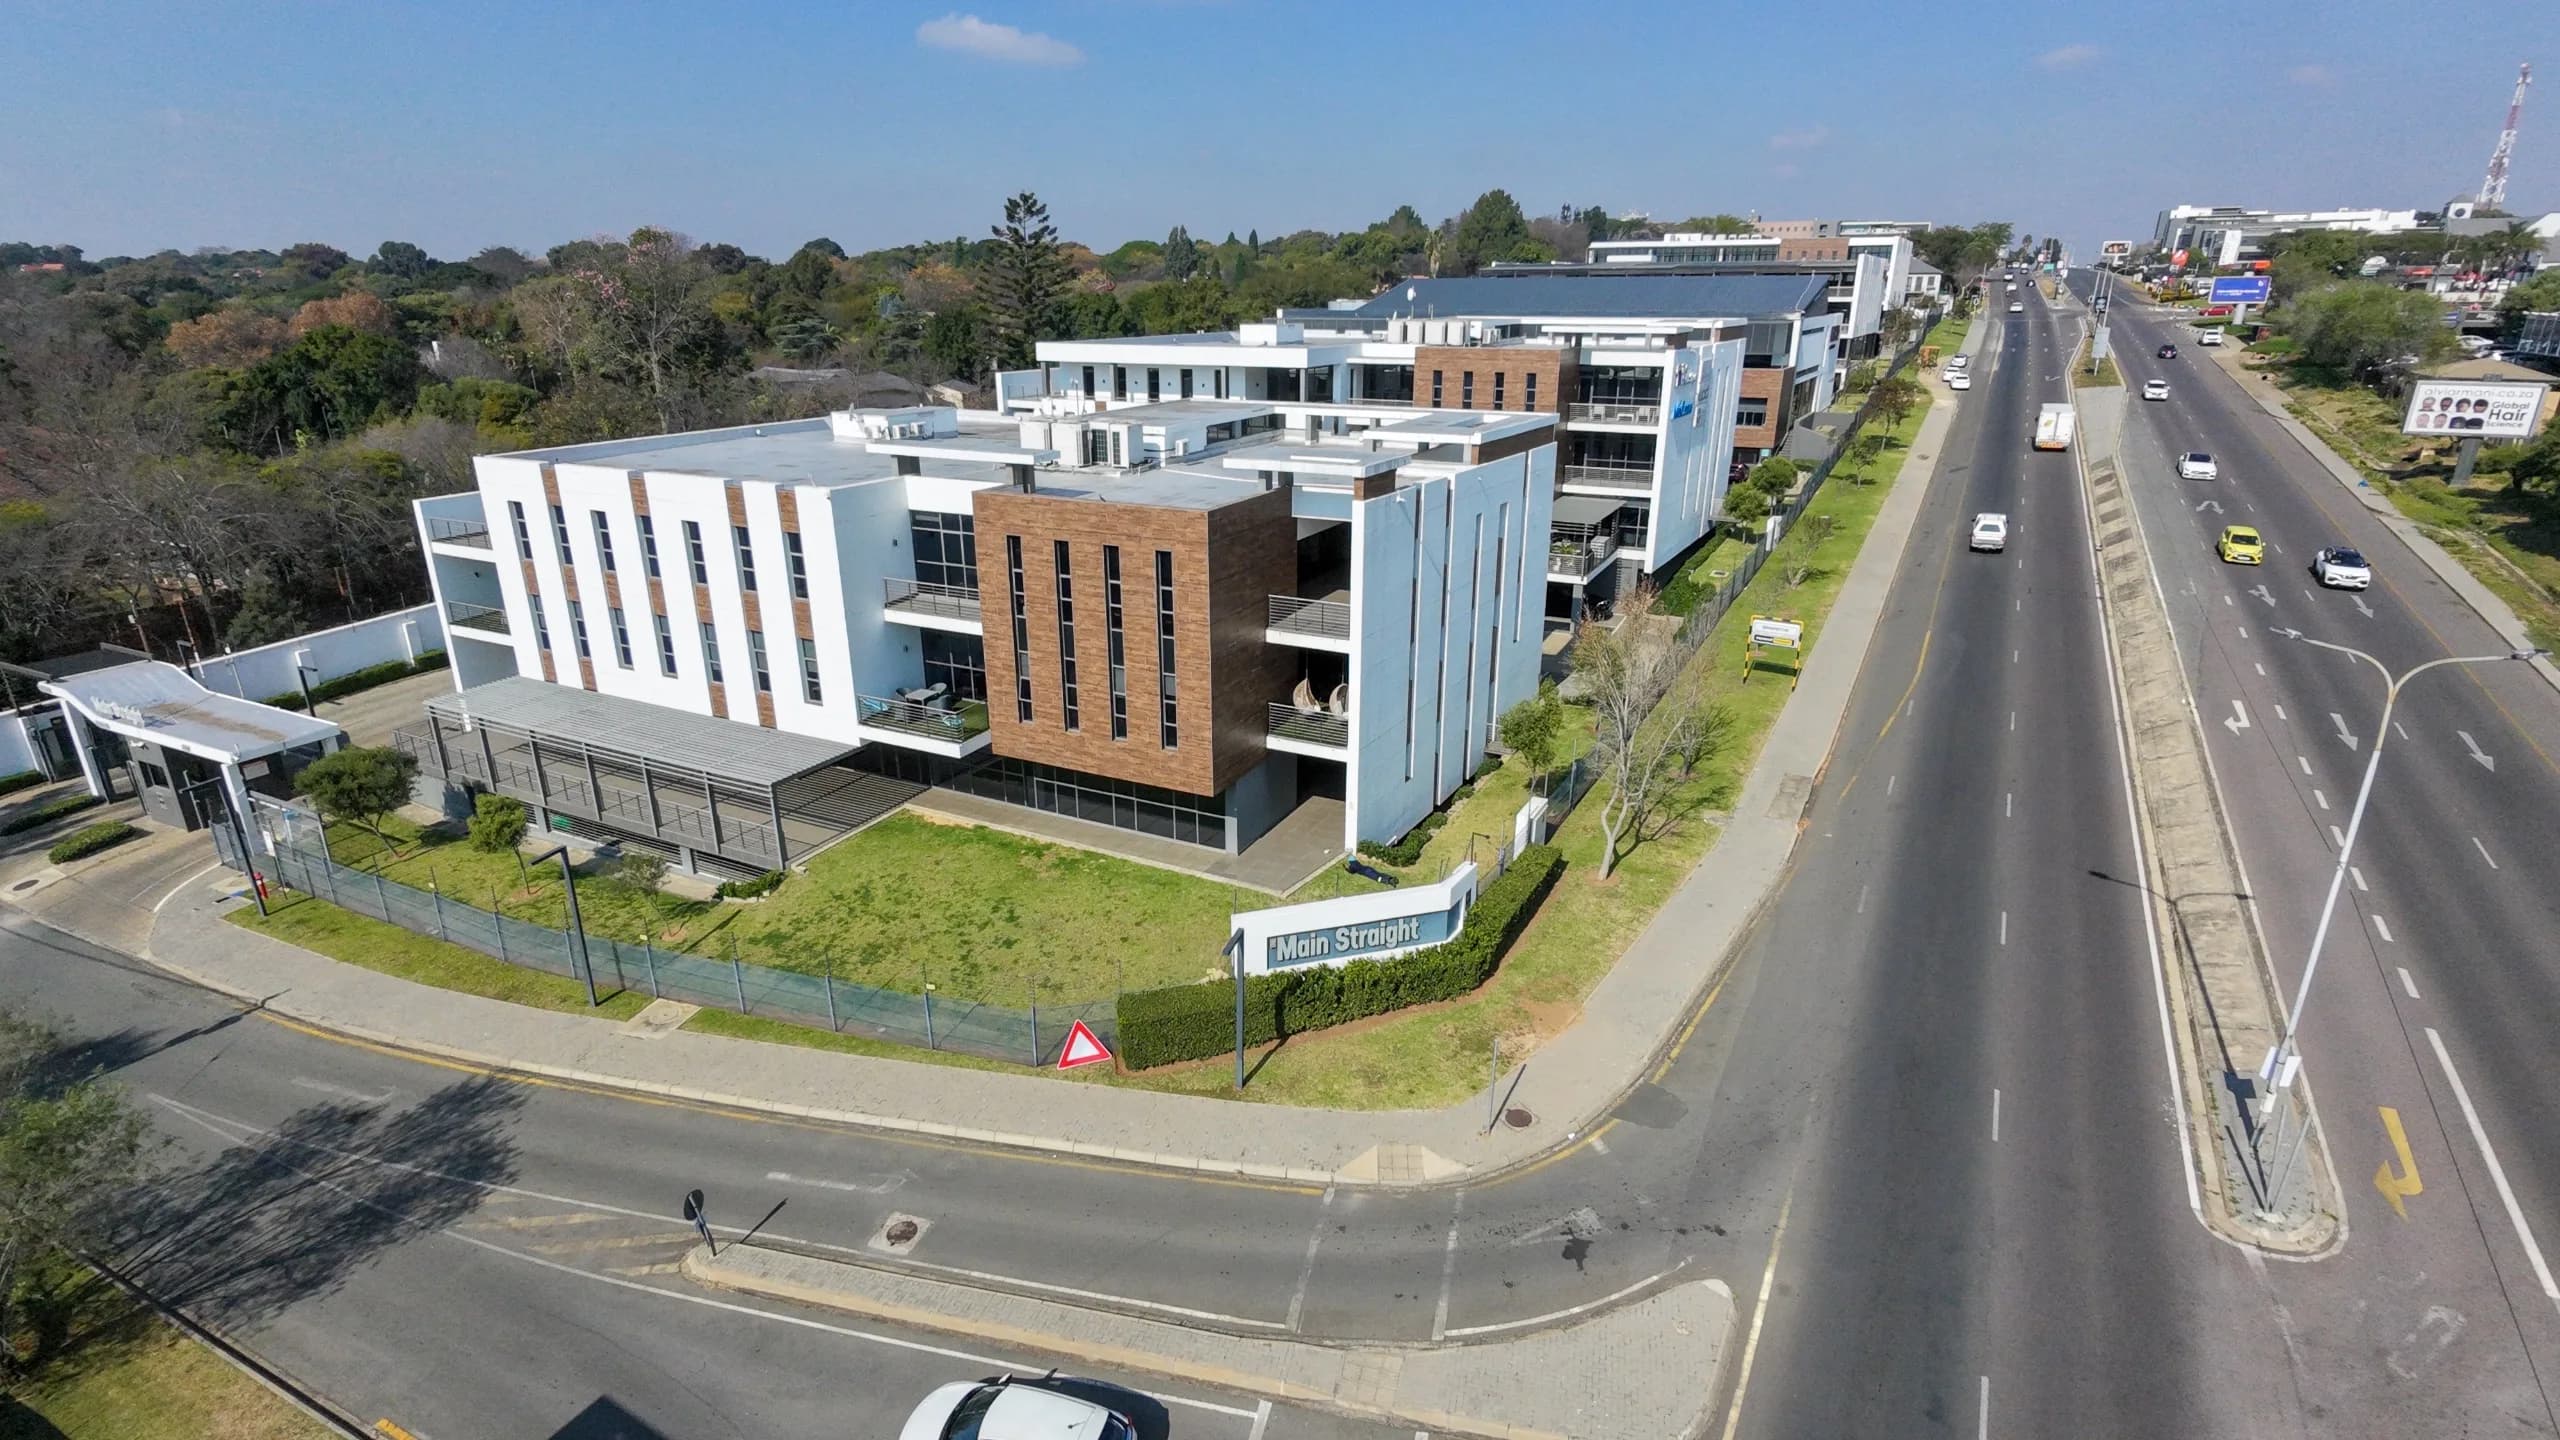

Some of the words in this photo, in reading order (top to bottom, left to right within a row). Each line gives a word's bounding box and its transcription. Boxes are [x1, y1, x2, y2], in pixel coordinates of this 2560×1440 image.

[2492, 401, 2530, 410] Global
[2488, 409, 2528, 421] Hair
[2485, 420, 2524, 428] Science
[1277, 933, 1329, 961] Main
[1335, 917, 1419, 951] Straight
